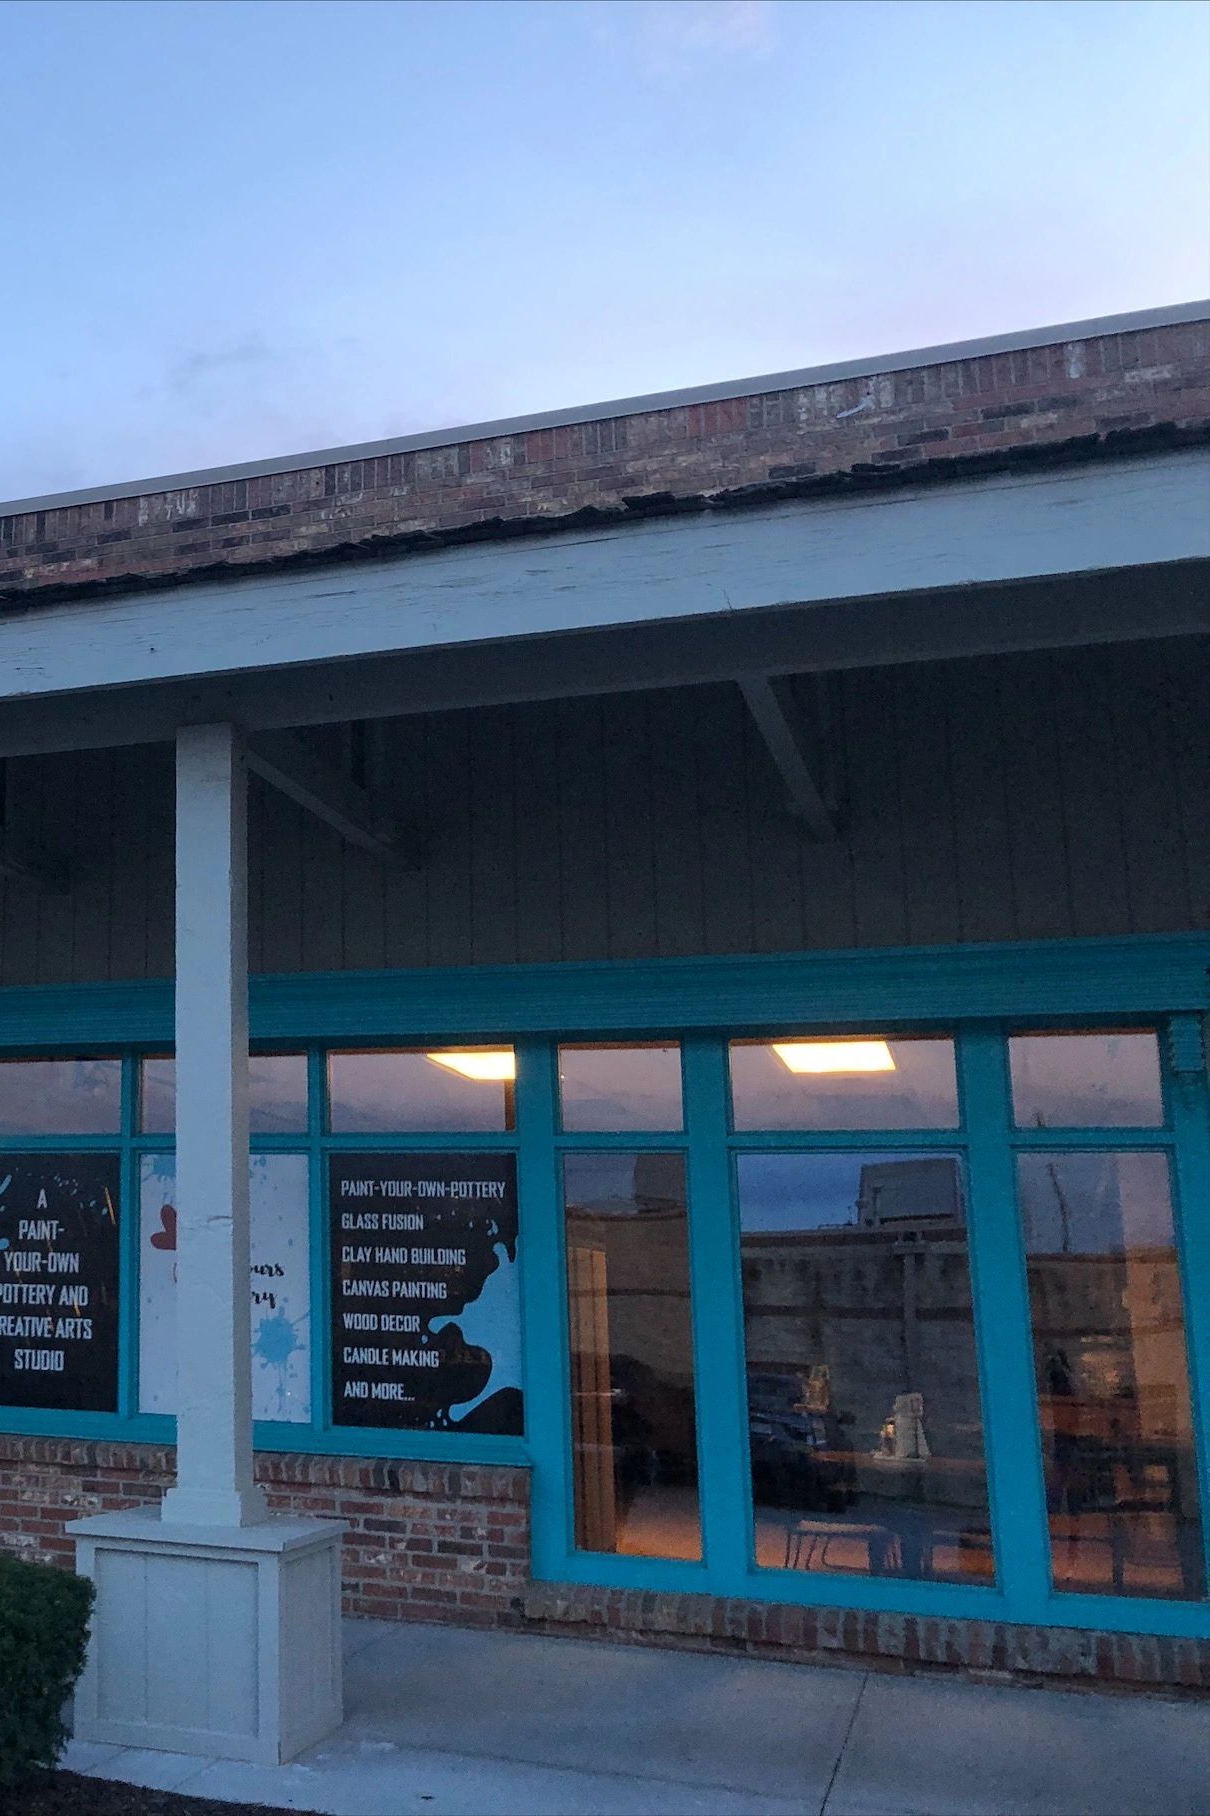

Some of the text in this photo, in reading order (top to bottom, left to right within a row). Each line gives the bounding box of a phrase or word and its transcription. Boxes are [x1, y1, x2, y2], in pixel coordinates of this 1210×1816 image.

[36, 1188, 48, 1209] A
[341, 1180, 506, 1199] PAINT-YOUR-OWN-POTTERY
[18, 1219, 65, 1241] PAINT-
[341, 1213, 424, 1231] GLASS FUSION
[4, 1251, 80, 1273] YOUR-OWN
[342, 1246, 466, 1266] CLAY HAND BUILDING
[58, 1285, 89, 1307] AND
[342, 1279, 447, 1299] CANVAS PAINTING
[55, 1317, 93, 1340] ARTS
[343, 1313, 420, 1332] WOOD DECOR
[14, 1348, 65, 1371] STUDIO
[343, 1347, 440, 1368] CANDLE MAKING
[344, 1381, 368, 1399] AND
